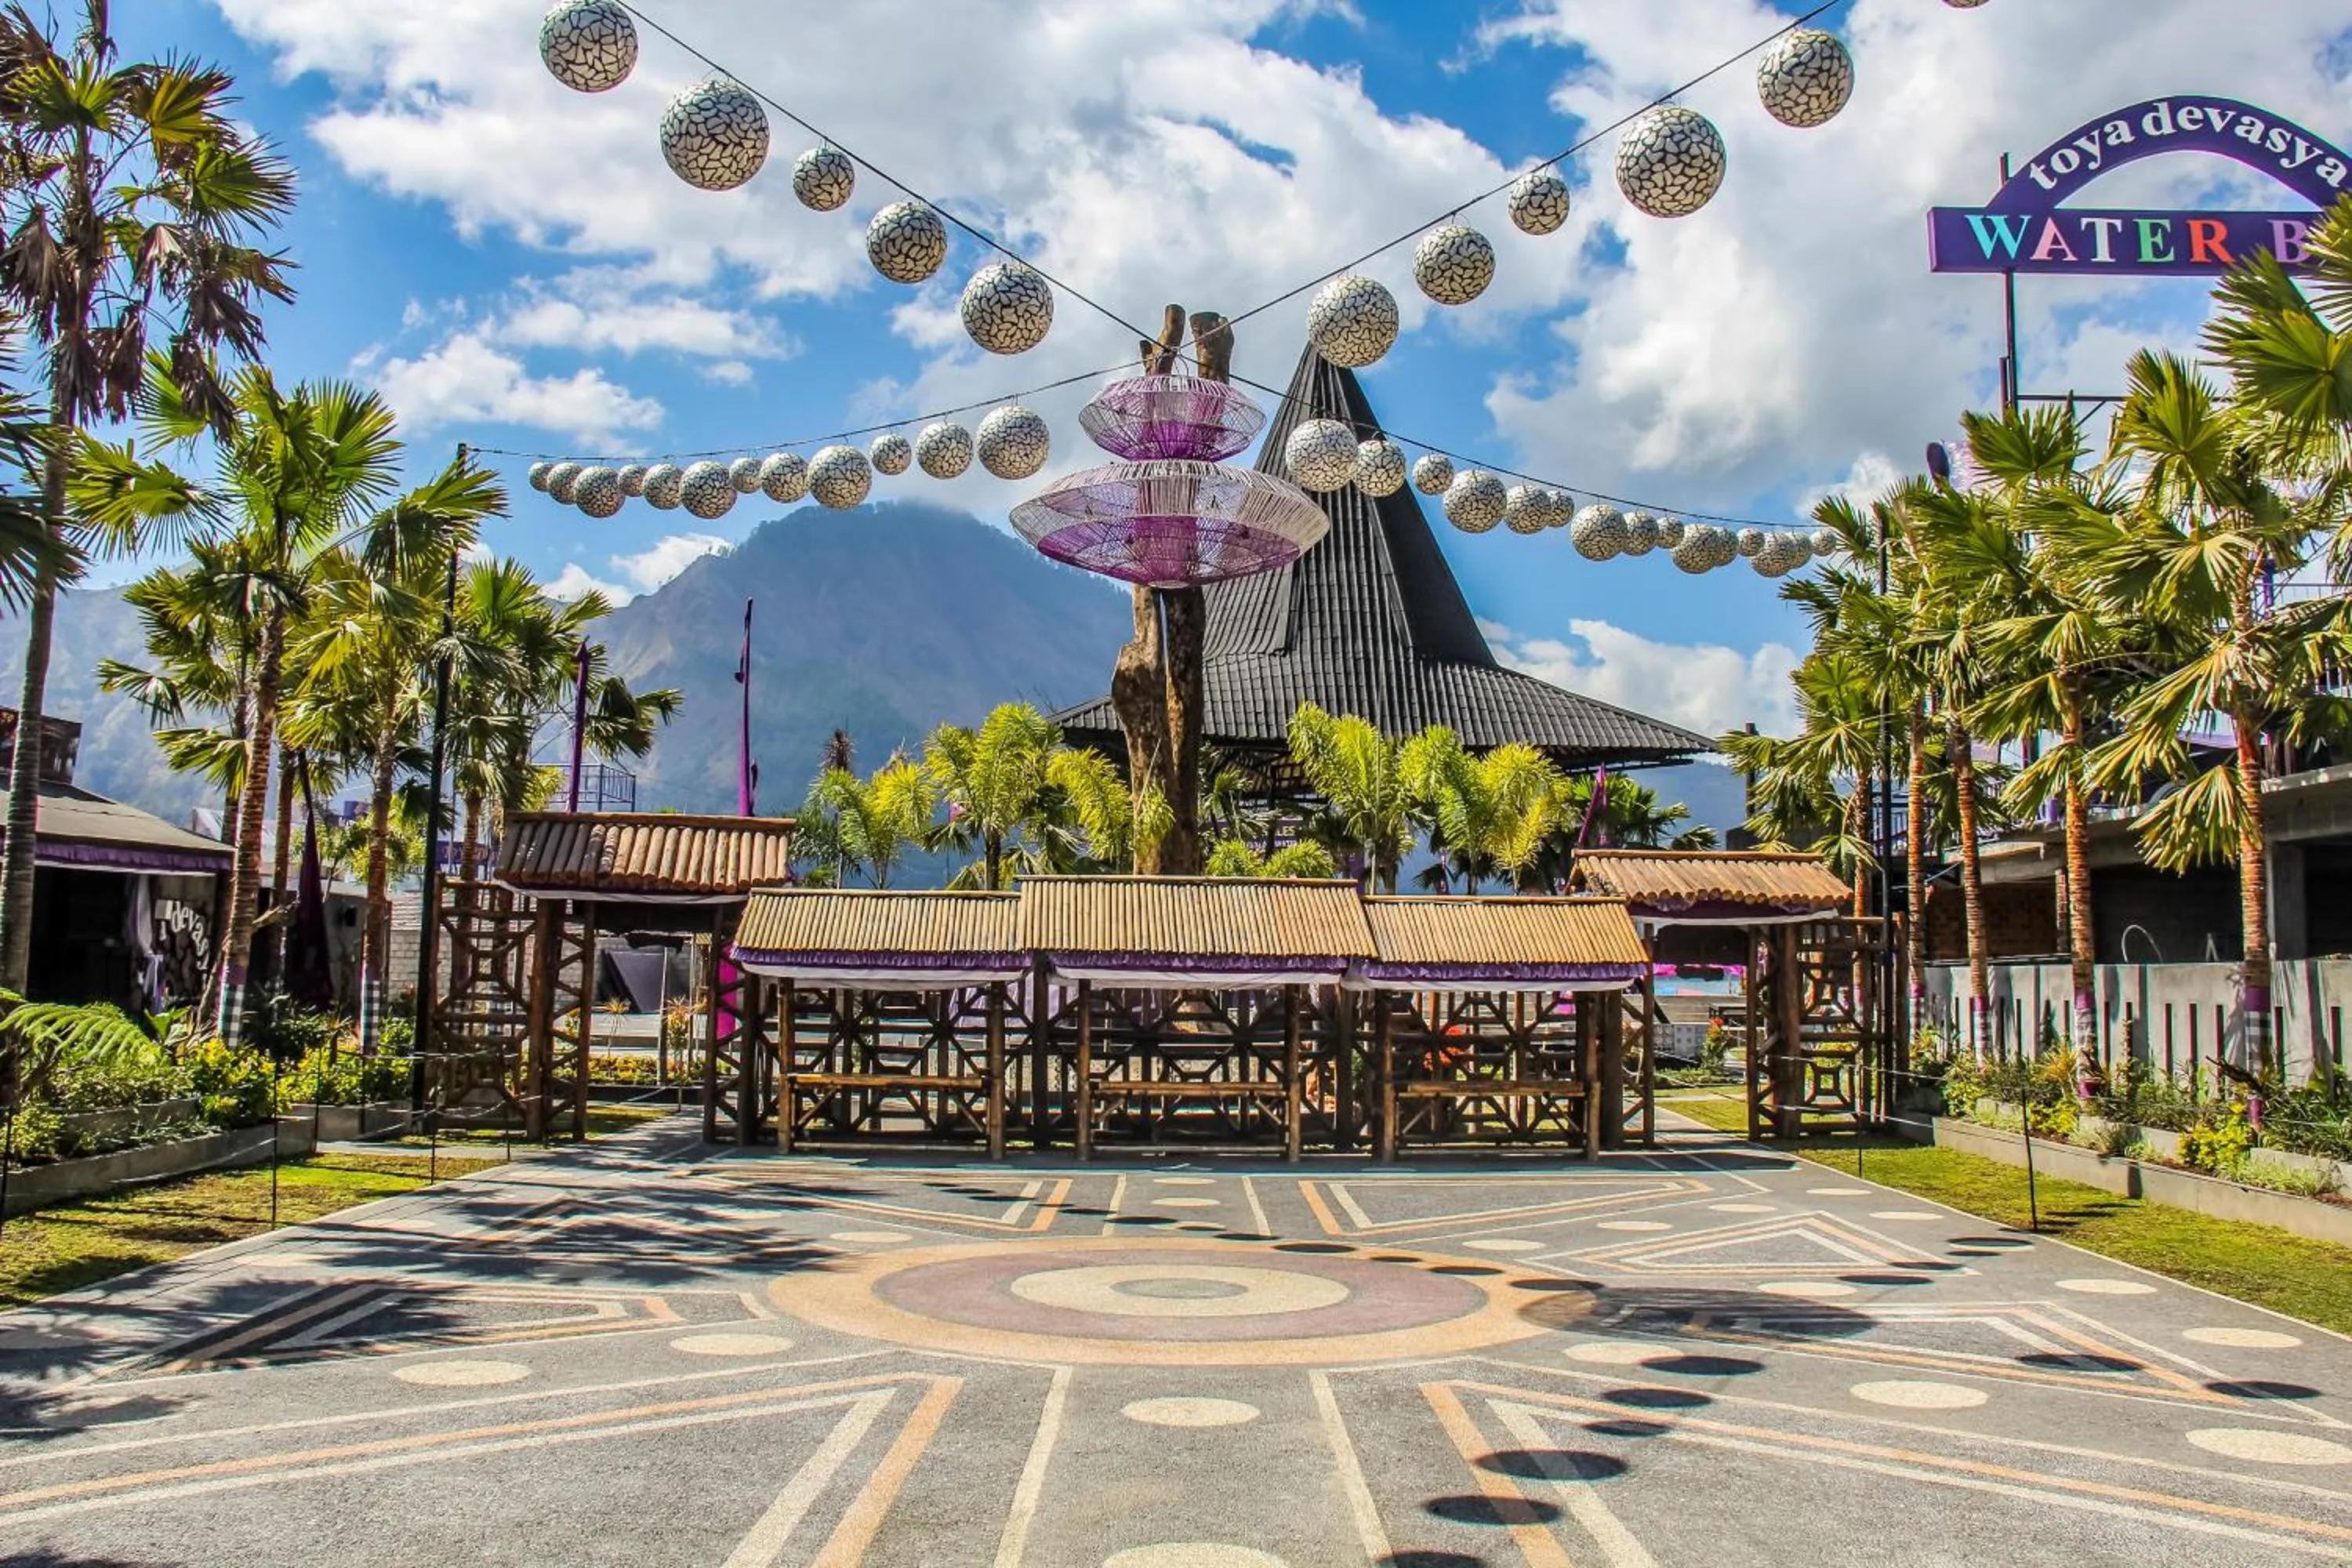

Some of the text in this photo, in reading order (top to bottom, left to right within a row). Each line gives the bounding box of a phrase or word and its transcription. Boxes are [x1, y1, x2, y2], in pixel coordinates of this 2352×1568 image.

[2029, 102, 2350, 191] toya devasya
[1965, 214, 2311, 264] WATER B
[172, 901, 210, 991] devasy
